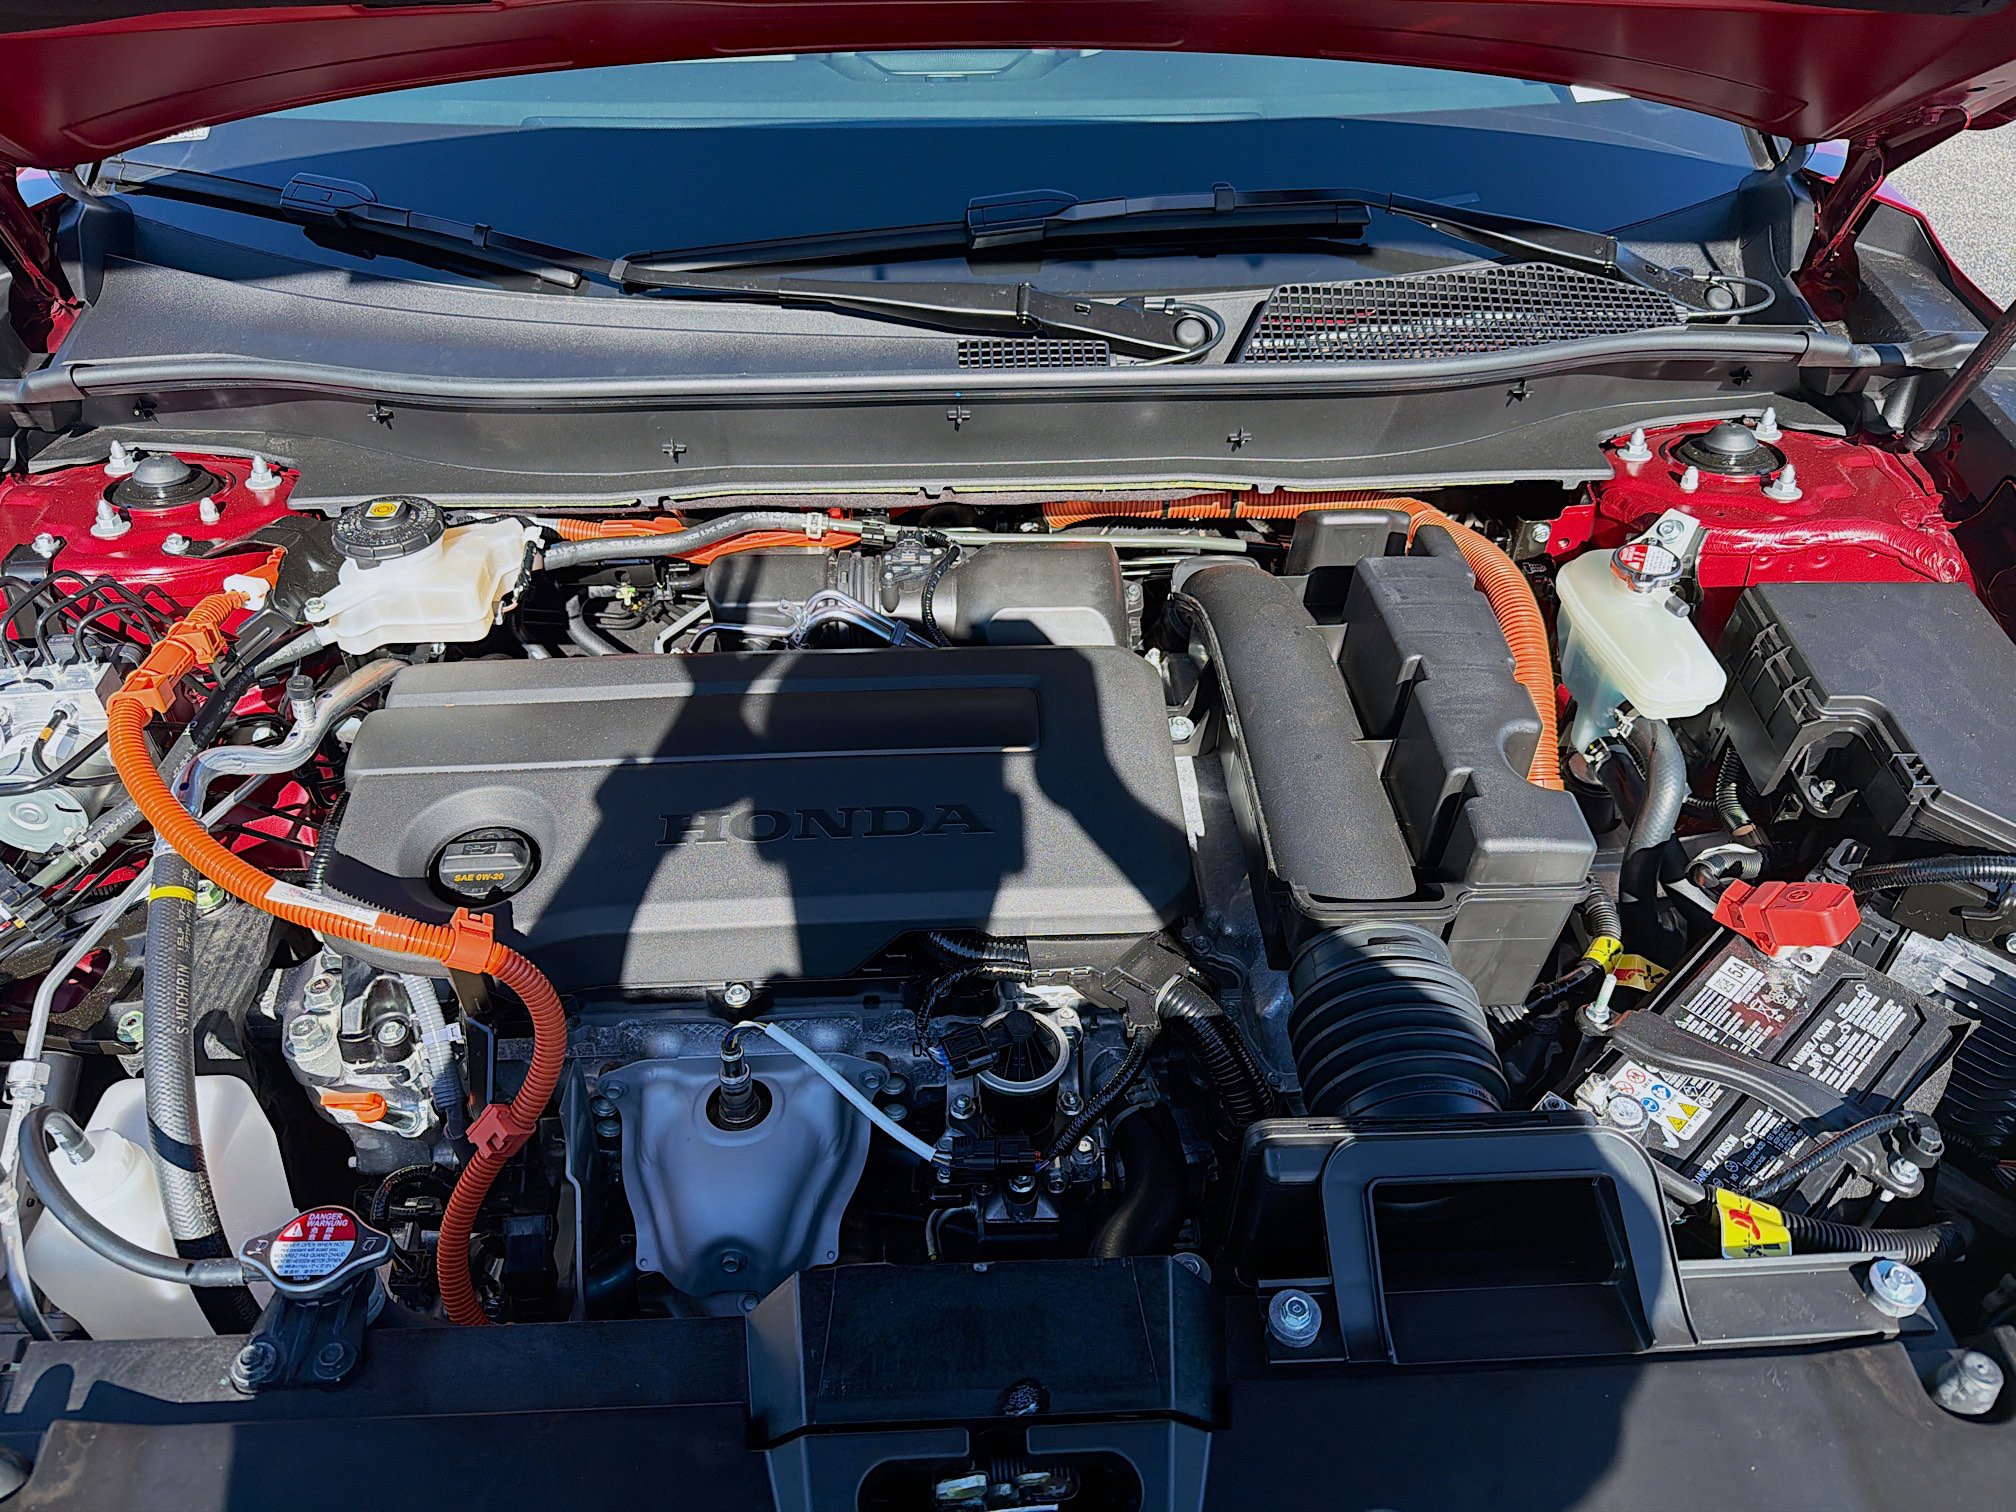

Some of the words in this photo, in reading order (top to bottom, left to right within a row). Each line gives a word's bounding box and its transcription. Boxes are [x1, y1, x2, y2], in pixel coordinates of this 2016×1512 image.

[653, 804, 995, 846] HONDA
[453, 873, 474, 883] SAE
[476, 872, 504, 882] 0W-20
[1727, 962, 1749, 978] 5A
[308, 1212, 343, 1220] DANGER
[307, 1219, 348, 1227] WARNUNG
